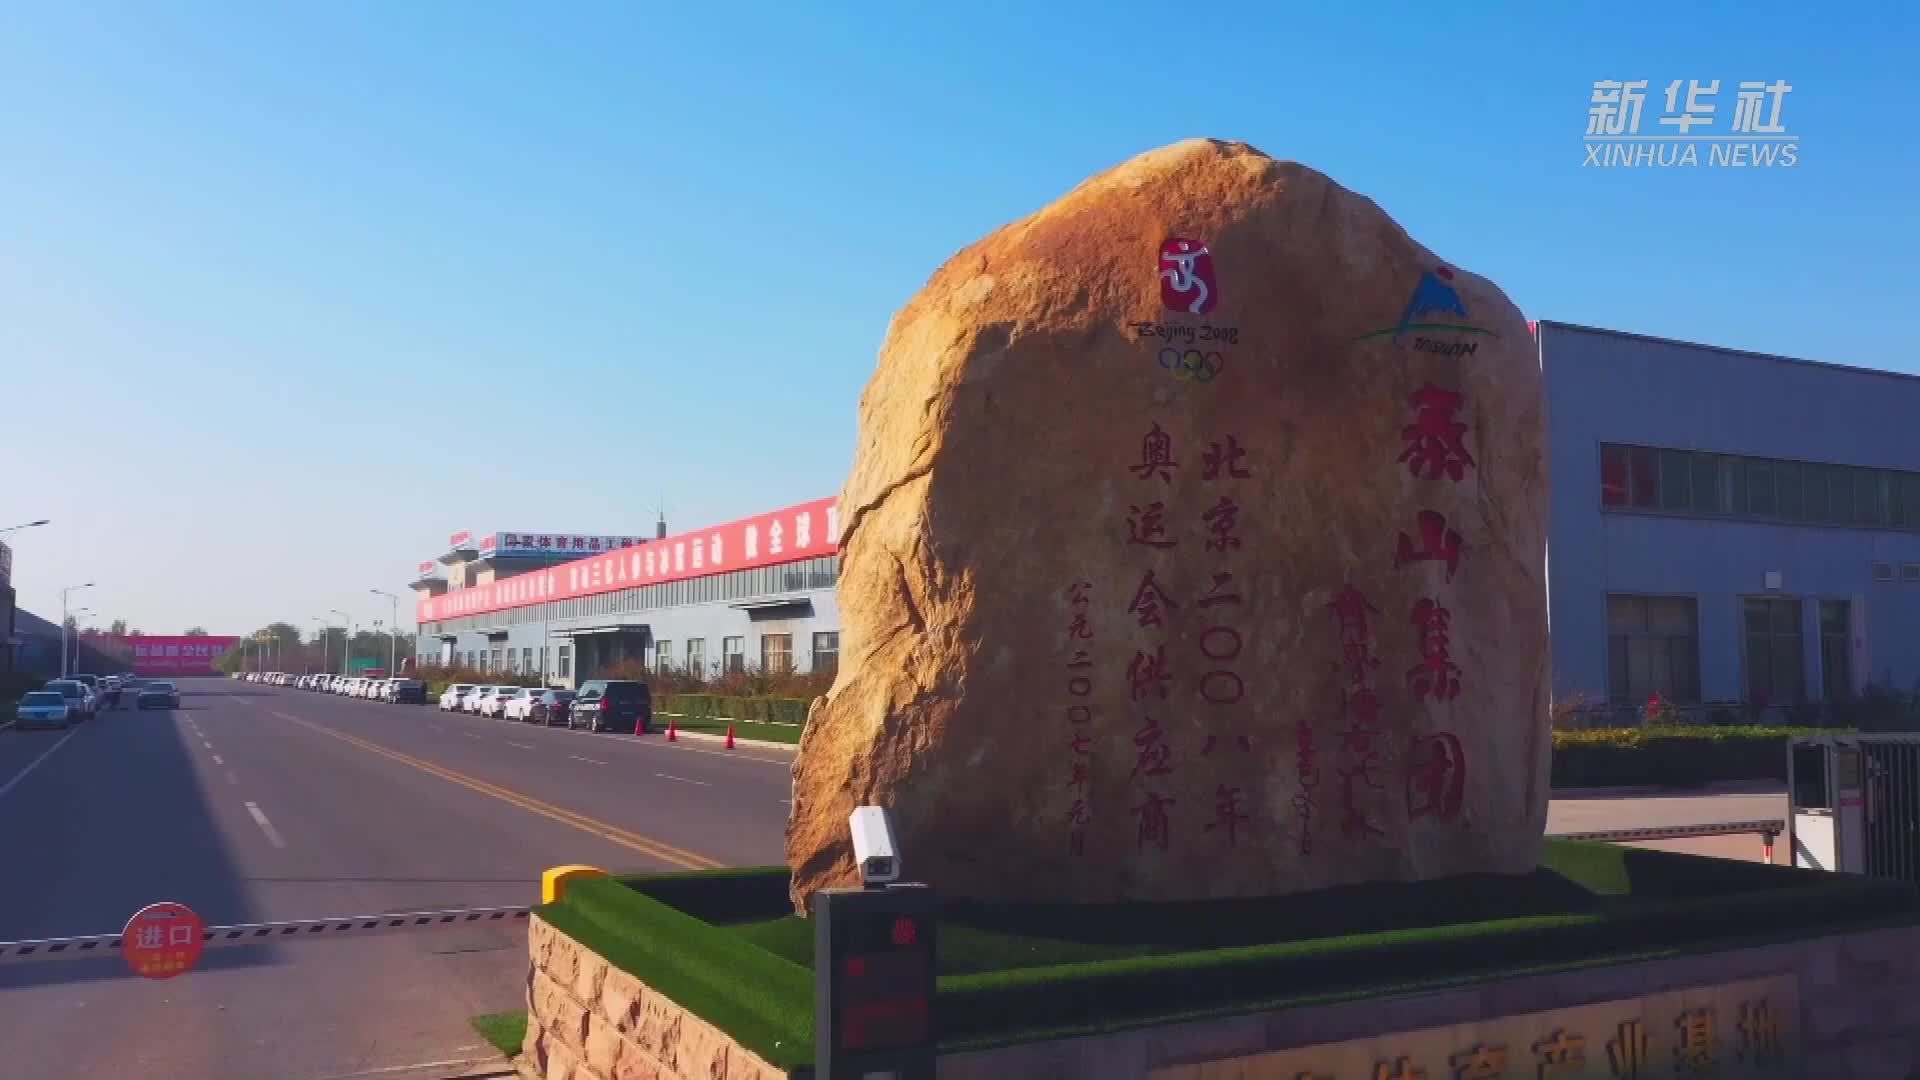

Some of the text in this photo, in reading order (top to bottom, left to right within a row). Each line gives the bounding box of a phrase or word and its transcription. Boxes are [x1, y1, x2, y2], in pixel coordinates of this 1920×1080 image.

[1129, 319, 1239, 346] Beijing 2008
[1125, 421, 1179, 851] 奥运会供应商
[135, 924, 193, 949] 进口
[1294, 998, 1783, 1080] 育产业基地
